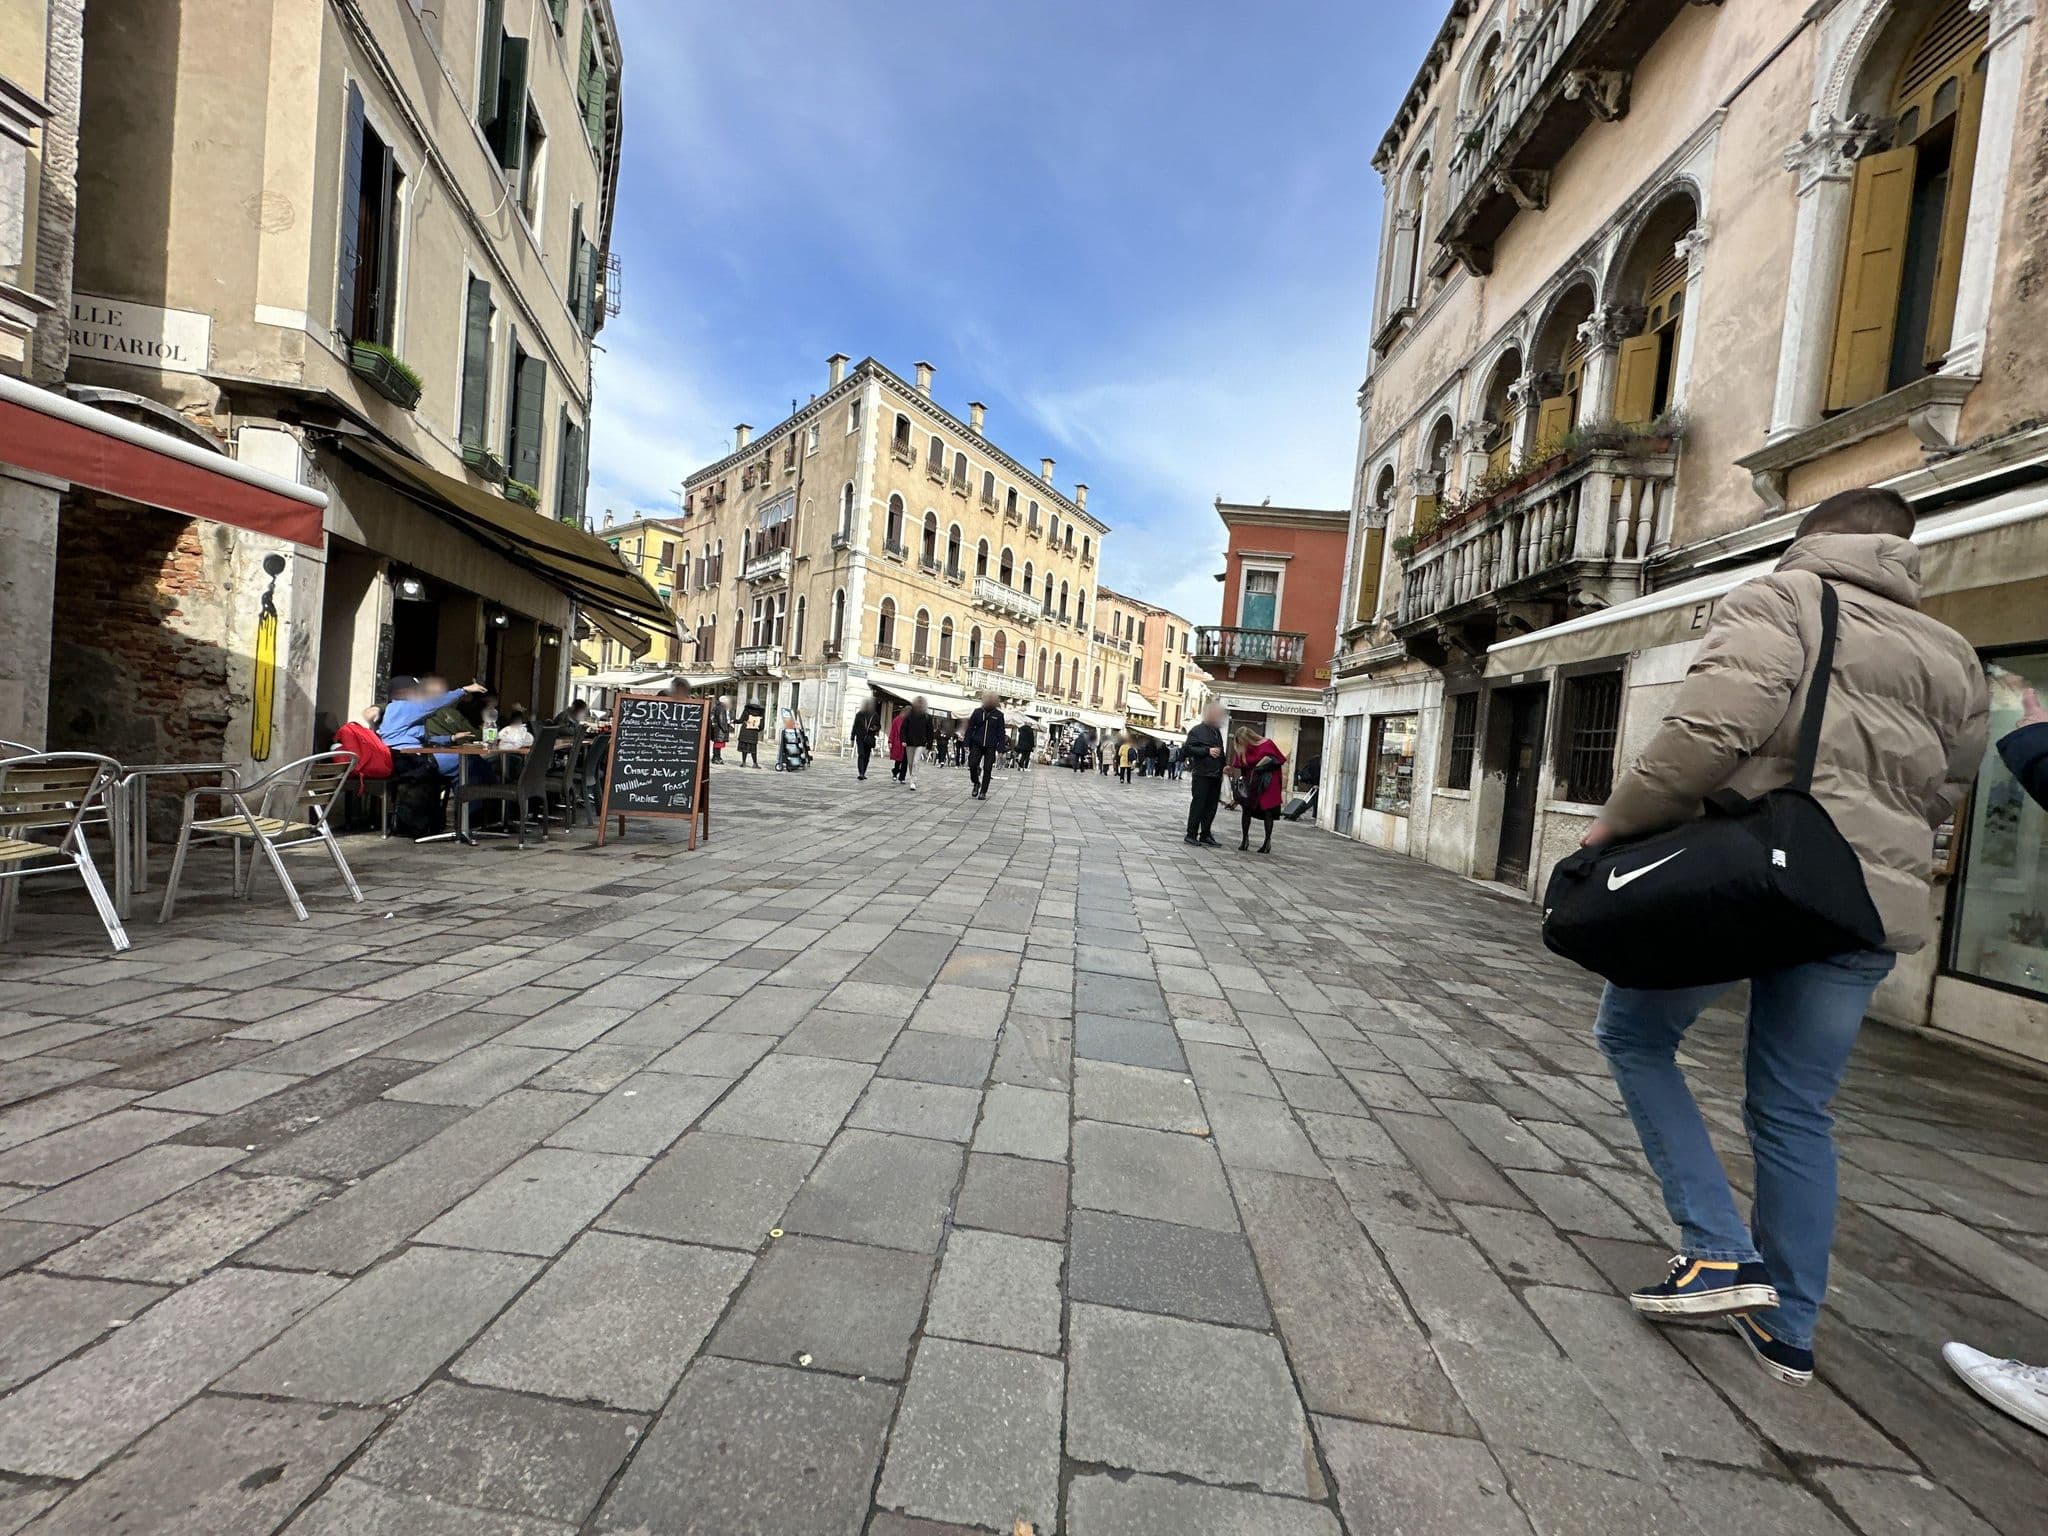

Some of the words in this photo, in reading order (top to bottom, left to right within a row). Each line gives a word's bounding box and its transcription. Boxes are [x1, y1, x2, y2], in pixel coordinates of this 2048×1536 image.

[74, 305, 122, 327] LLE
[69, 329, 187, 362] RUTARIOL
[1036, 705, 1052, 714] BANCO
[663, 780, 690, 791] TOAST
